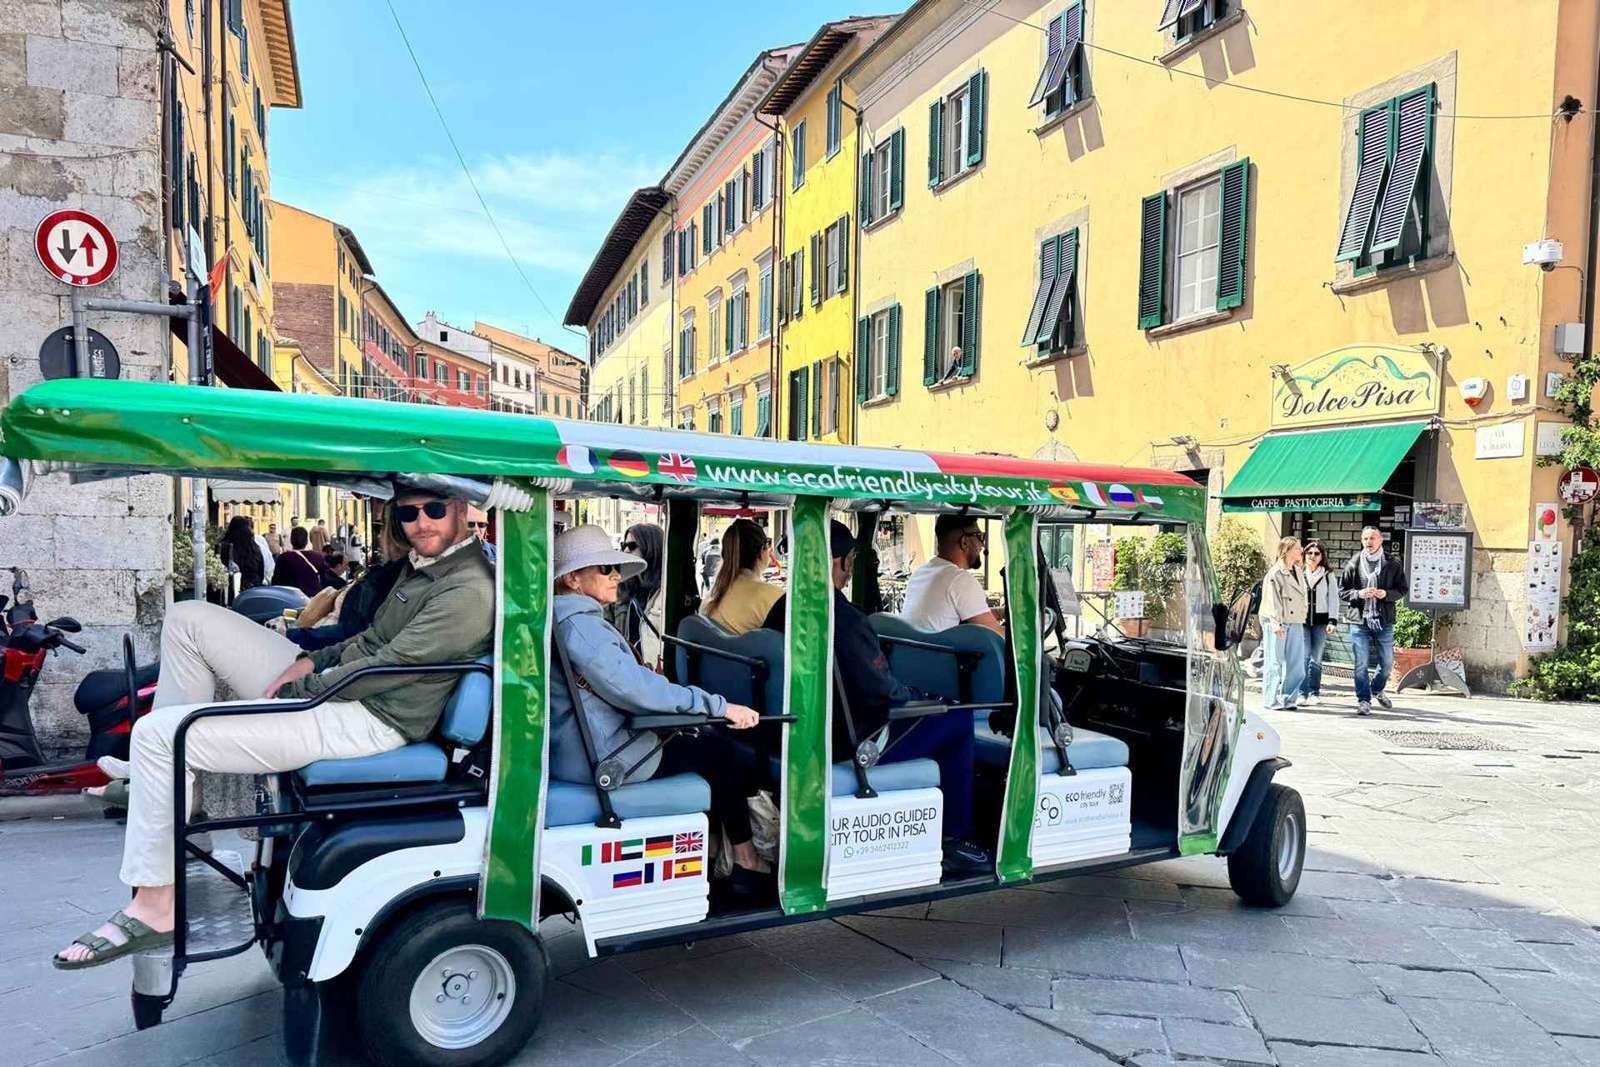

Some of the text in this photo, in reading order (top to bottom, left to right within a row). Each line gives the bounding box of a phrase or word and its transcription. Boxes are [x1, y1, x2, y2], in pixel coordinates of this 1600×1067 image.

[1282, 381, 1422, 417] Dolce Pisa
[705, 464, 1042, 502] www.ecofriendlycitytour.it
[1285, 498, 1344, 508] PASTICCERIA
[1065, 788, 1106, 802] ECO friendly
[832, 807, 937, 831] UR AUDIO GUIDED
[831, 822, 927, 846] ITY TOUR IN PISA
